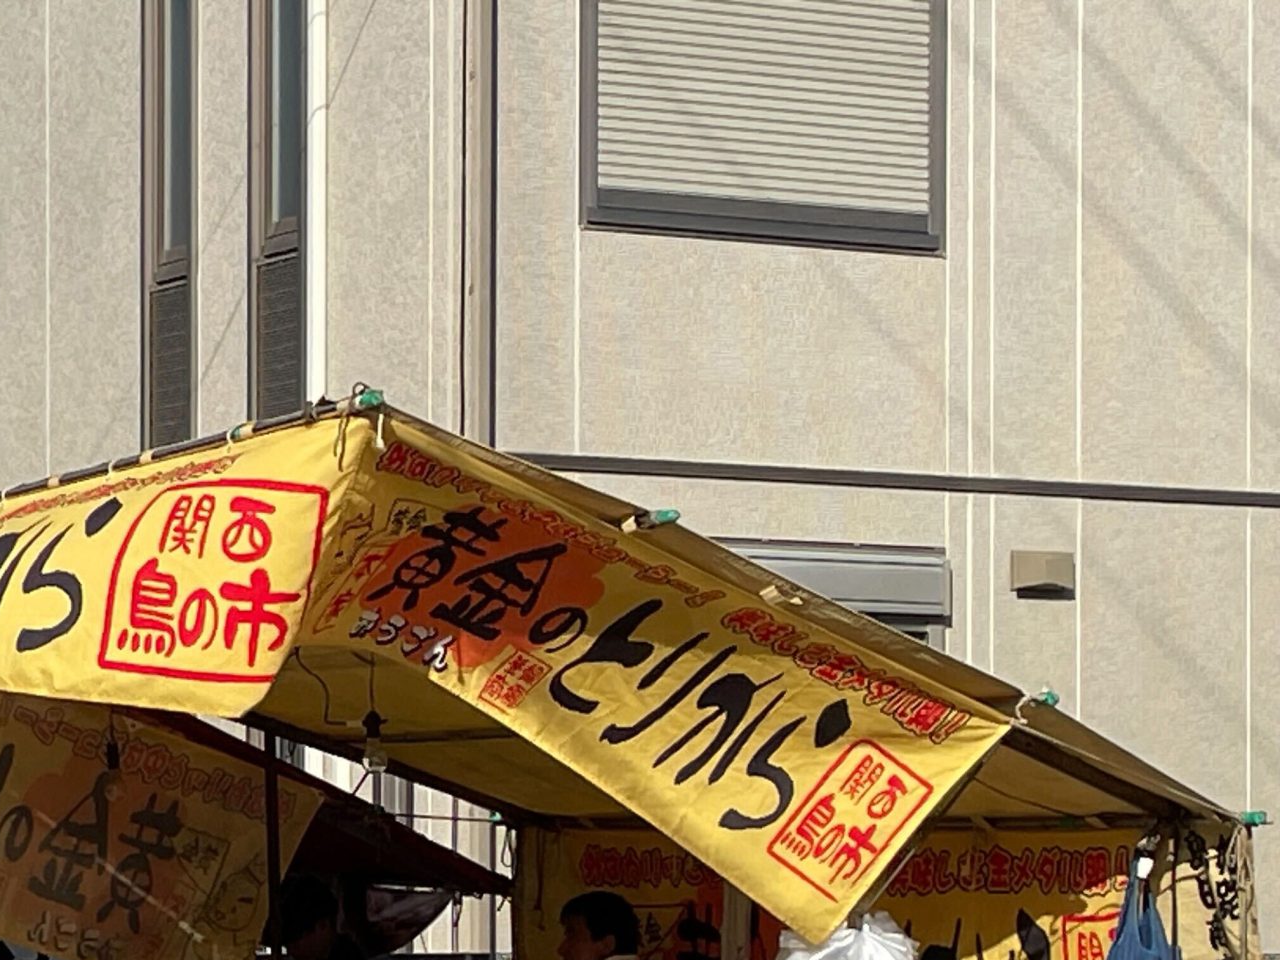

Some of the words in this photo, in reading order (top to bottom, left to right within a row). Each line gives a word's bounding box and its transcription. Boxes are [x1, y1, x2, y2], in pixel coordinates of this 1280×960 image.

[158, 492, 278, 561] 関西
[118, 557, 300, 668] 鳥の市
[840, 754, 908, 820] 関西
[780, 792, 879, 885] 鳥の市
